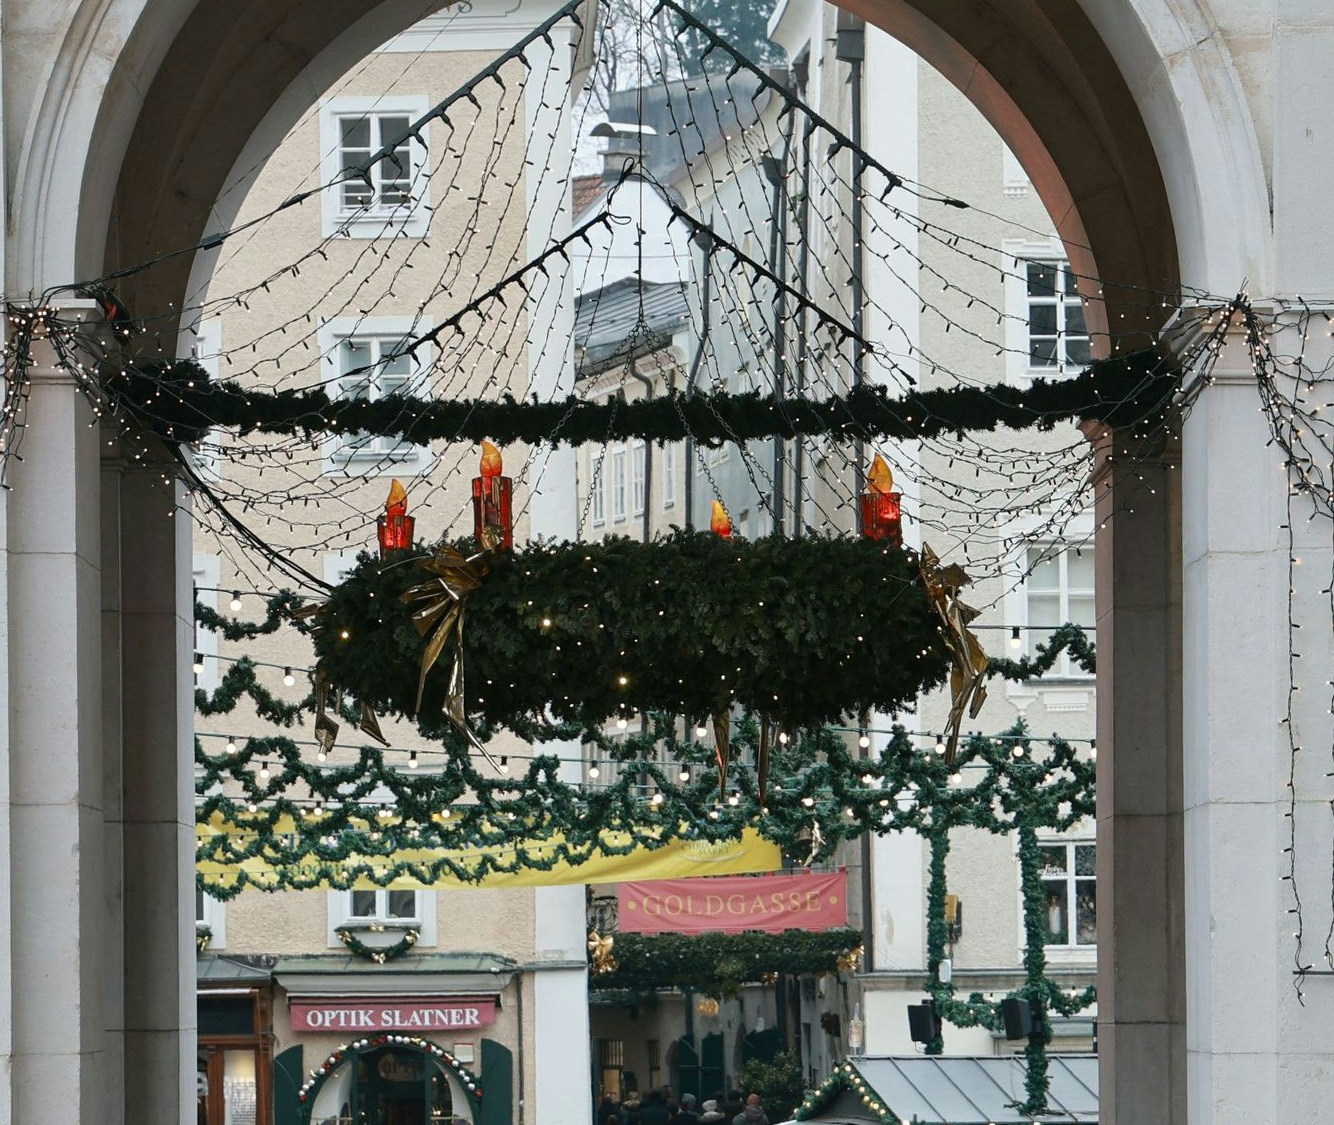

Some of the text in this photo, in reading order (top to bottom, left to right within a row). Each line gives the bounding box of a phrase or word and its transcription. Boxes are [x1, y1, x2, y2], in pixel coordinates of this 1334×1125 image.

[642, 891, 821, 916] GOLDGASSE
[306, 1008, 481, 1028] OPTIK SLATNER
